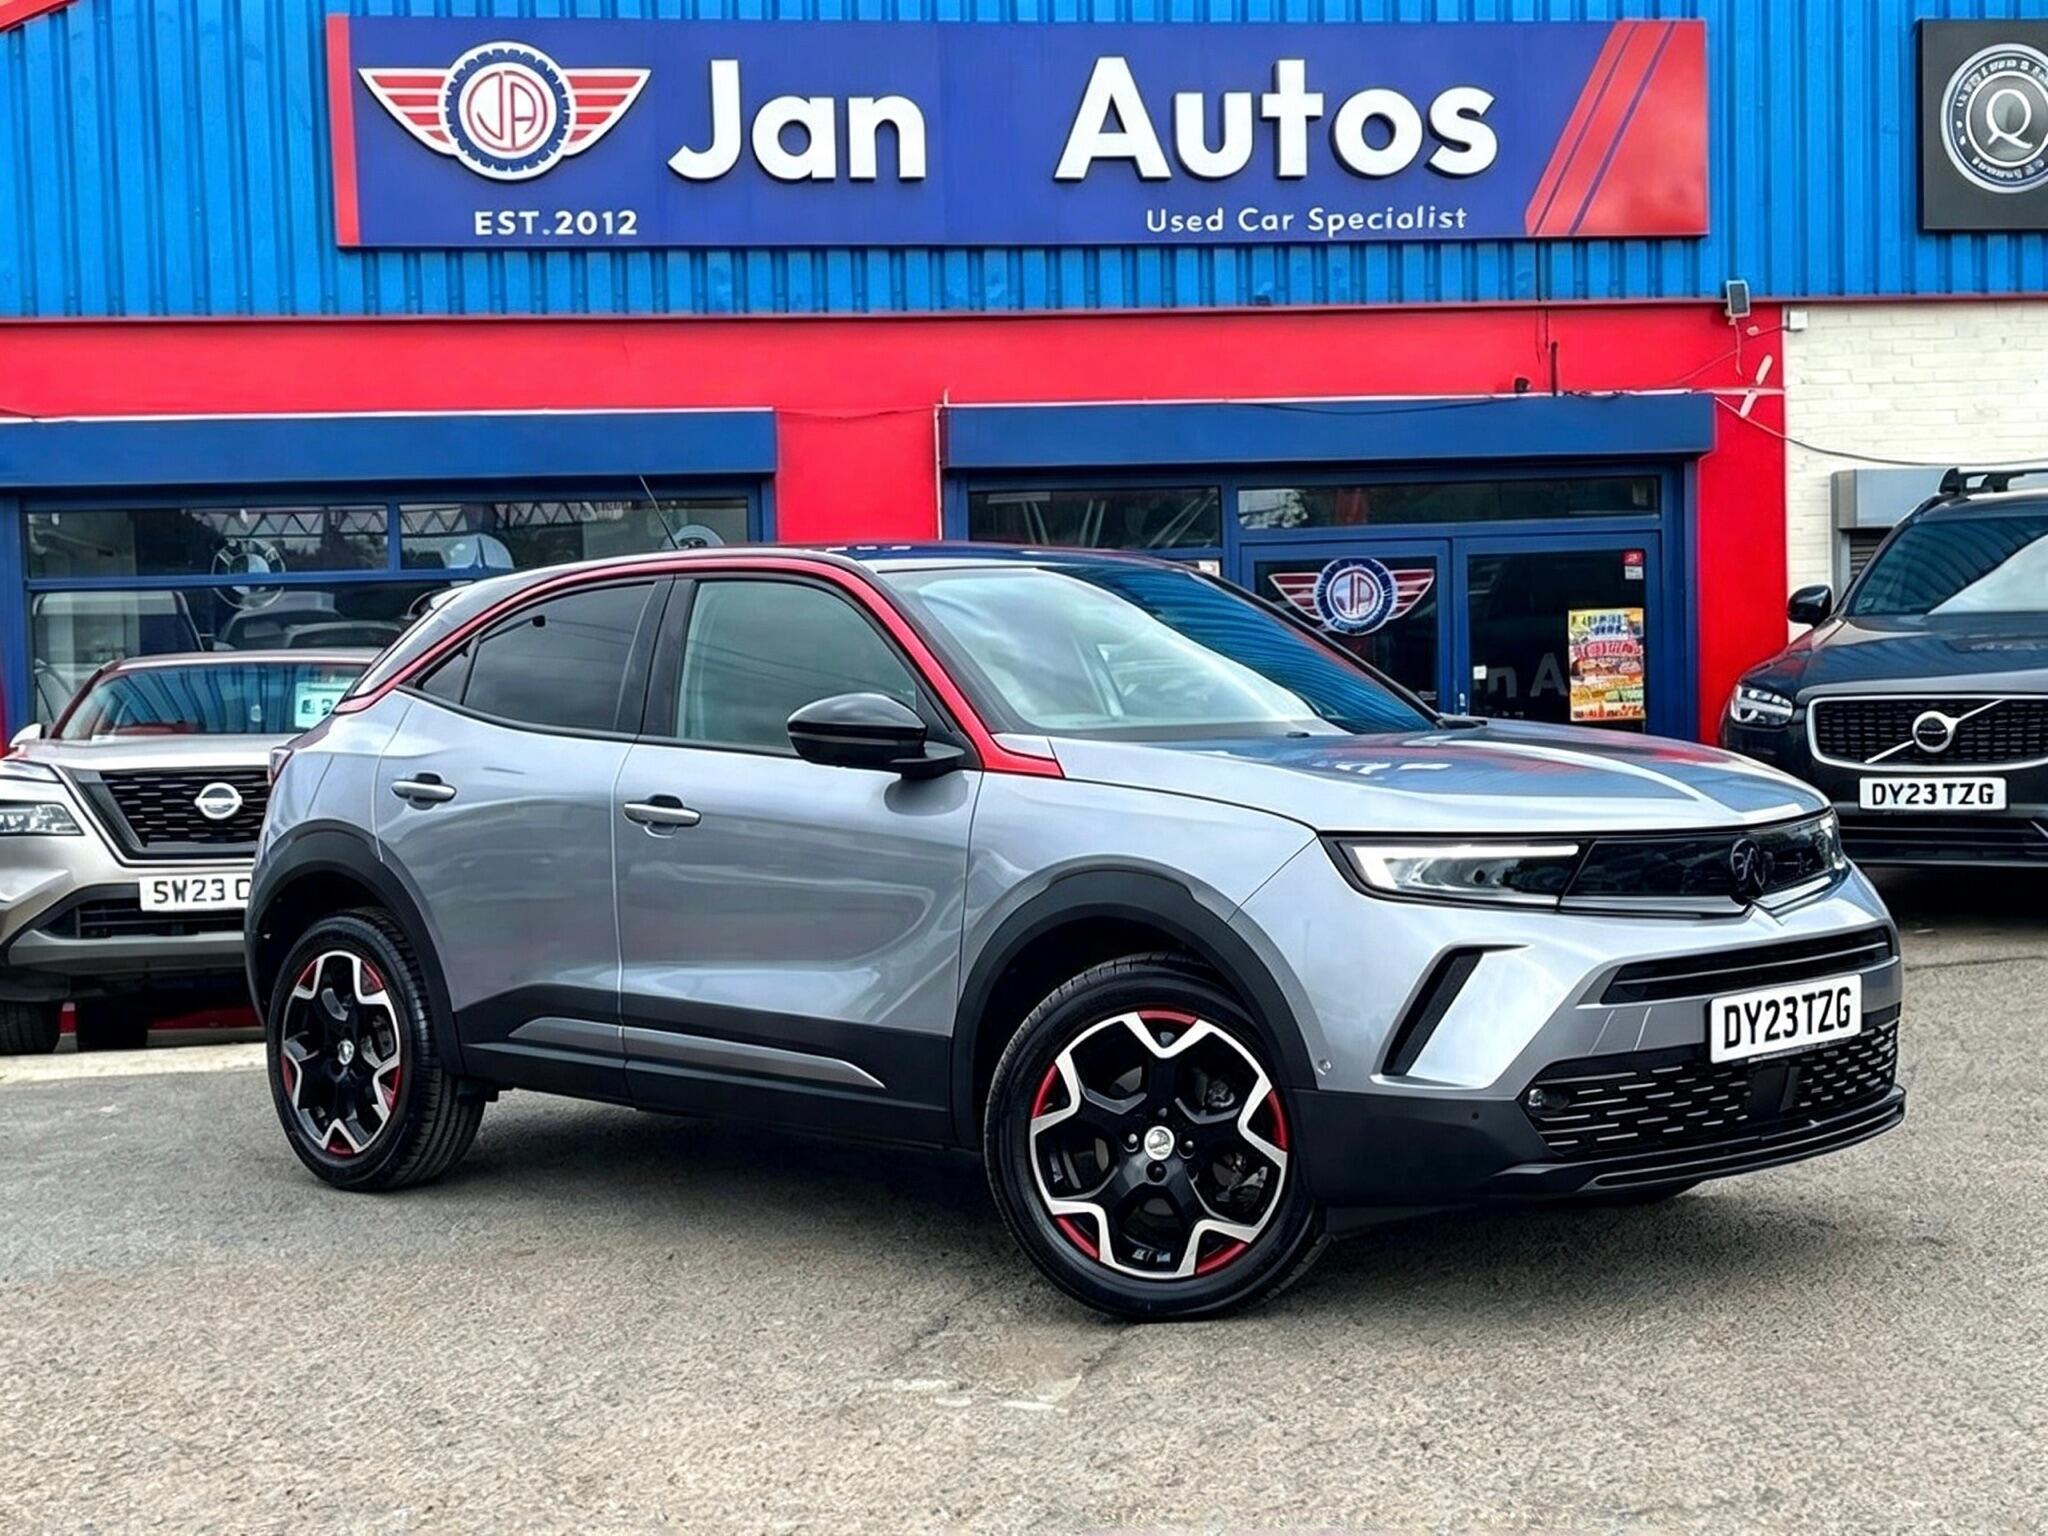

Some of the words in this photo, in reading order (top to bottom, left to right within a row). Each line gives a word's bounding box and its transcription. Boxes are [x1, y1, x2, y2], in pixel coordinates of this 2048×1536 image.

[667, 59, 925, 180] Jan
[1053, 55, 1499, 180] Autos
[1986, 88, 2033, 150] Q
[1146, 207, 1224, 233] Used
[1237, 207, 1294, 232] Car
[1307, 205, 1468, 238] Specialist
[153, 878, 226, 904] SW23
